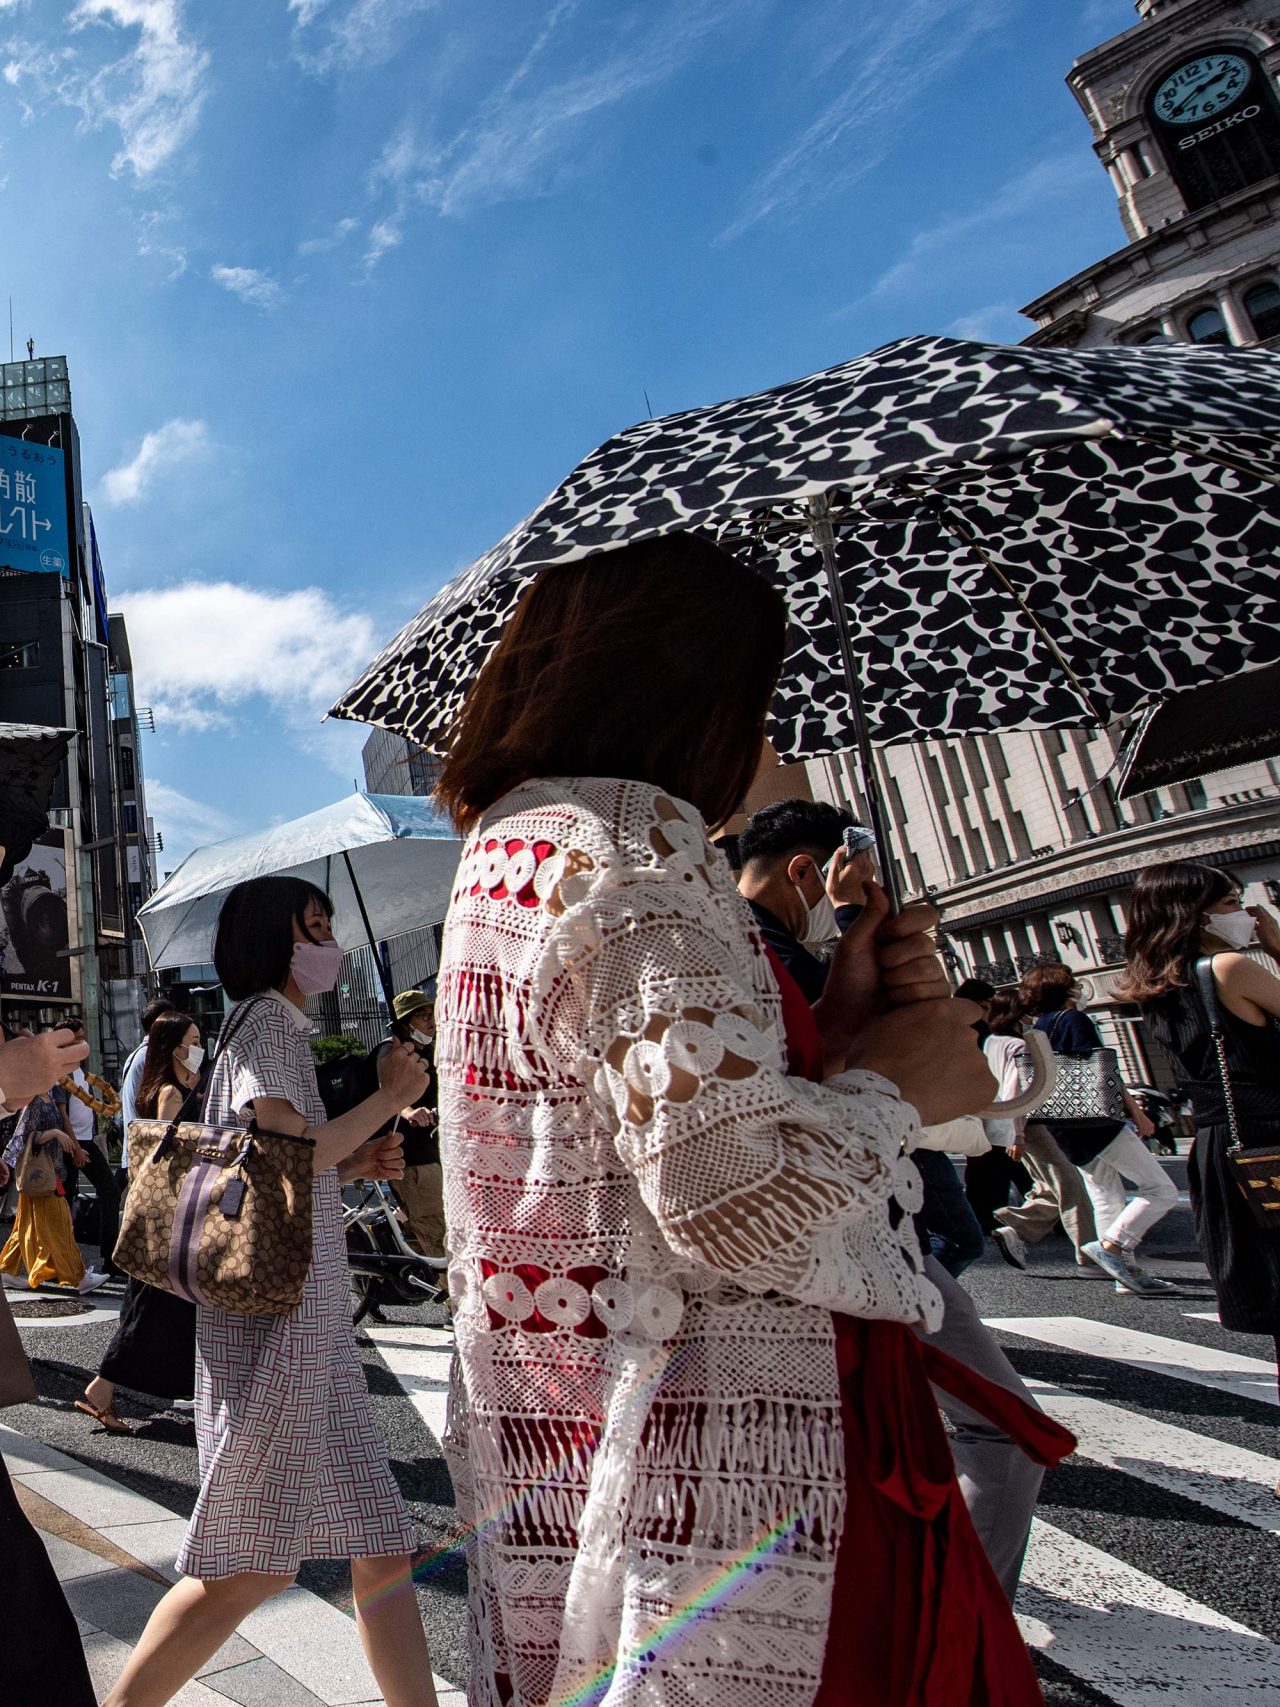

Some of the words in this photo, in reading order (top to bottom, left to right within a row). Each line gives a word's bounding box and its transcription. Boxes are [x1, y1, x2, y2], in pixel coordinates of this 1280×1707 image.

[1178, 105, 1261, 150] SEIKO
[10, 981, 36, 991] PENTAX
[37, 979, 59, 993] K-1
